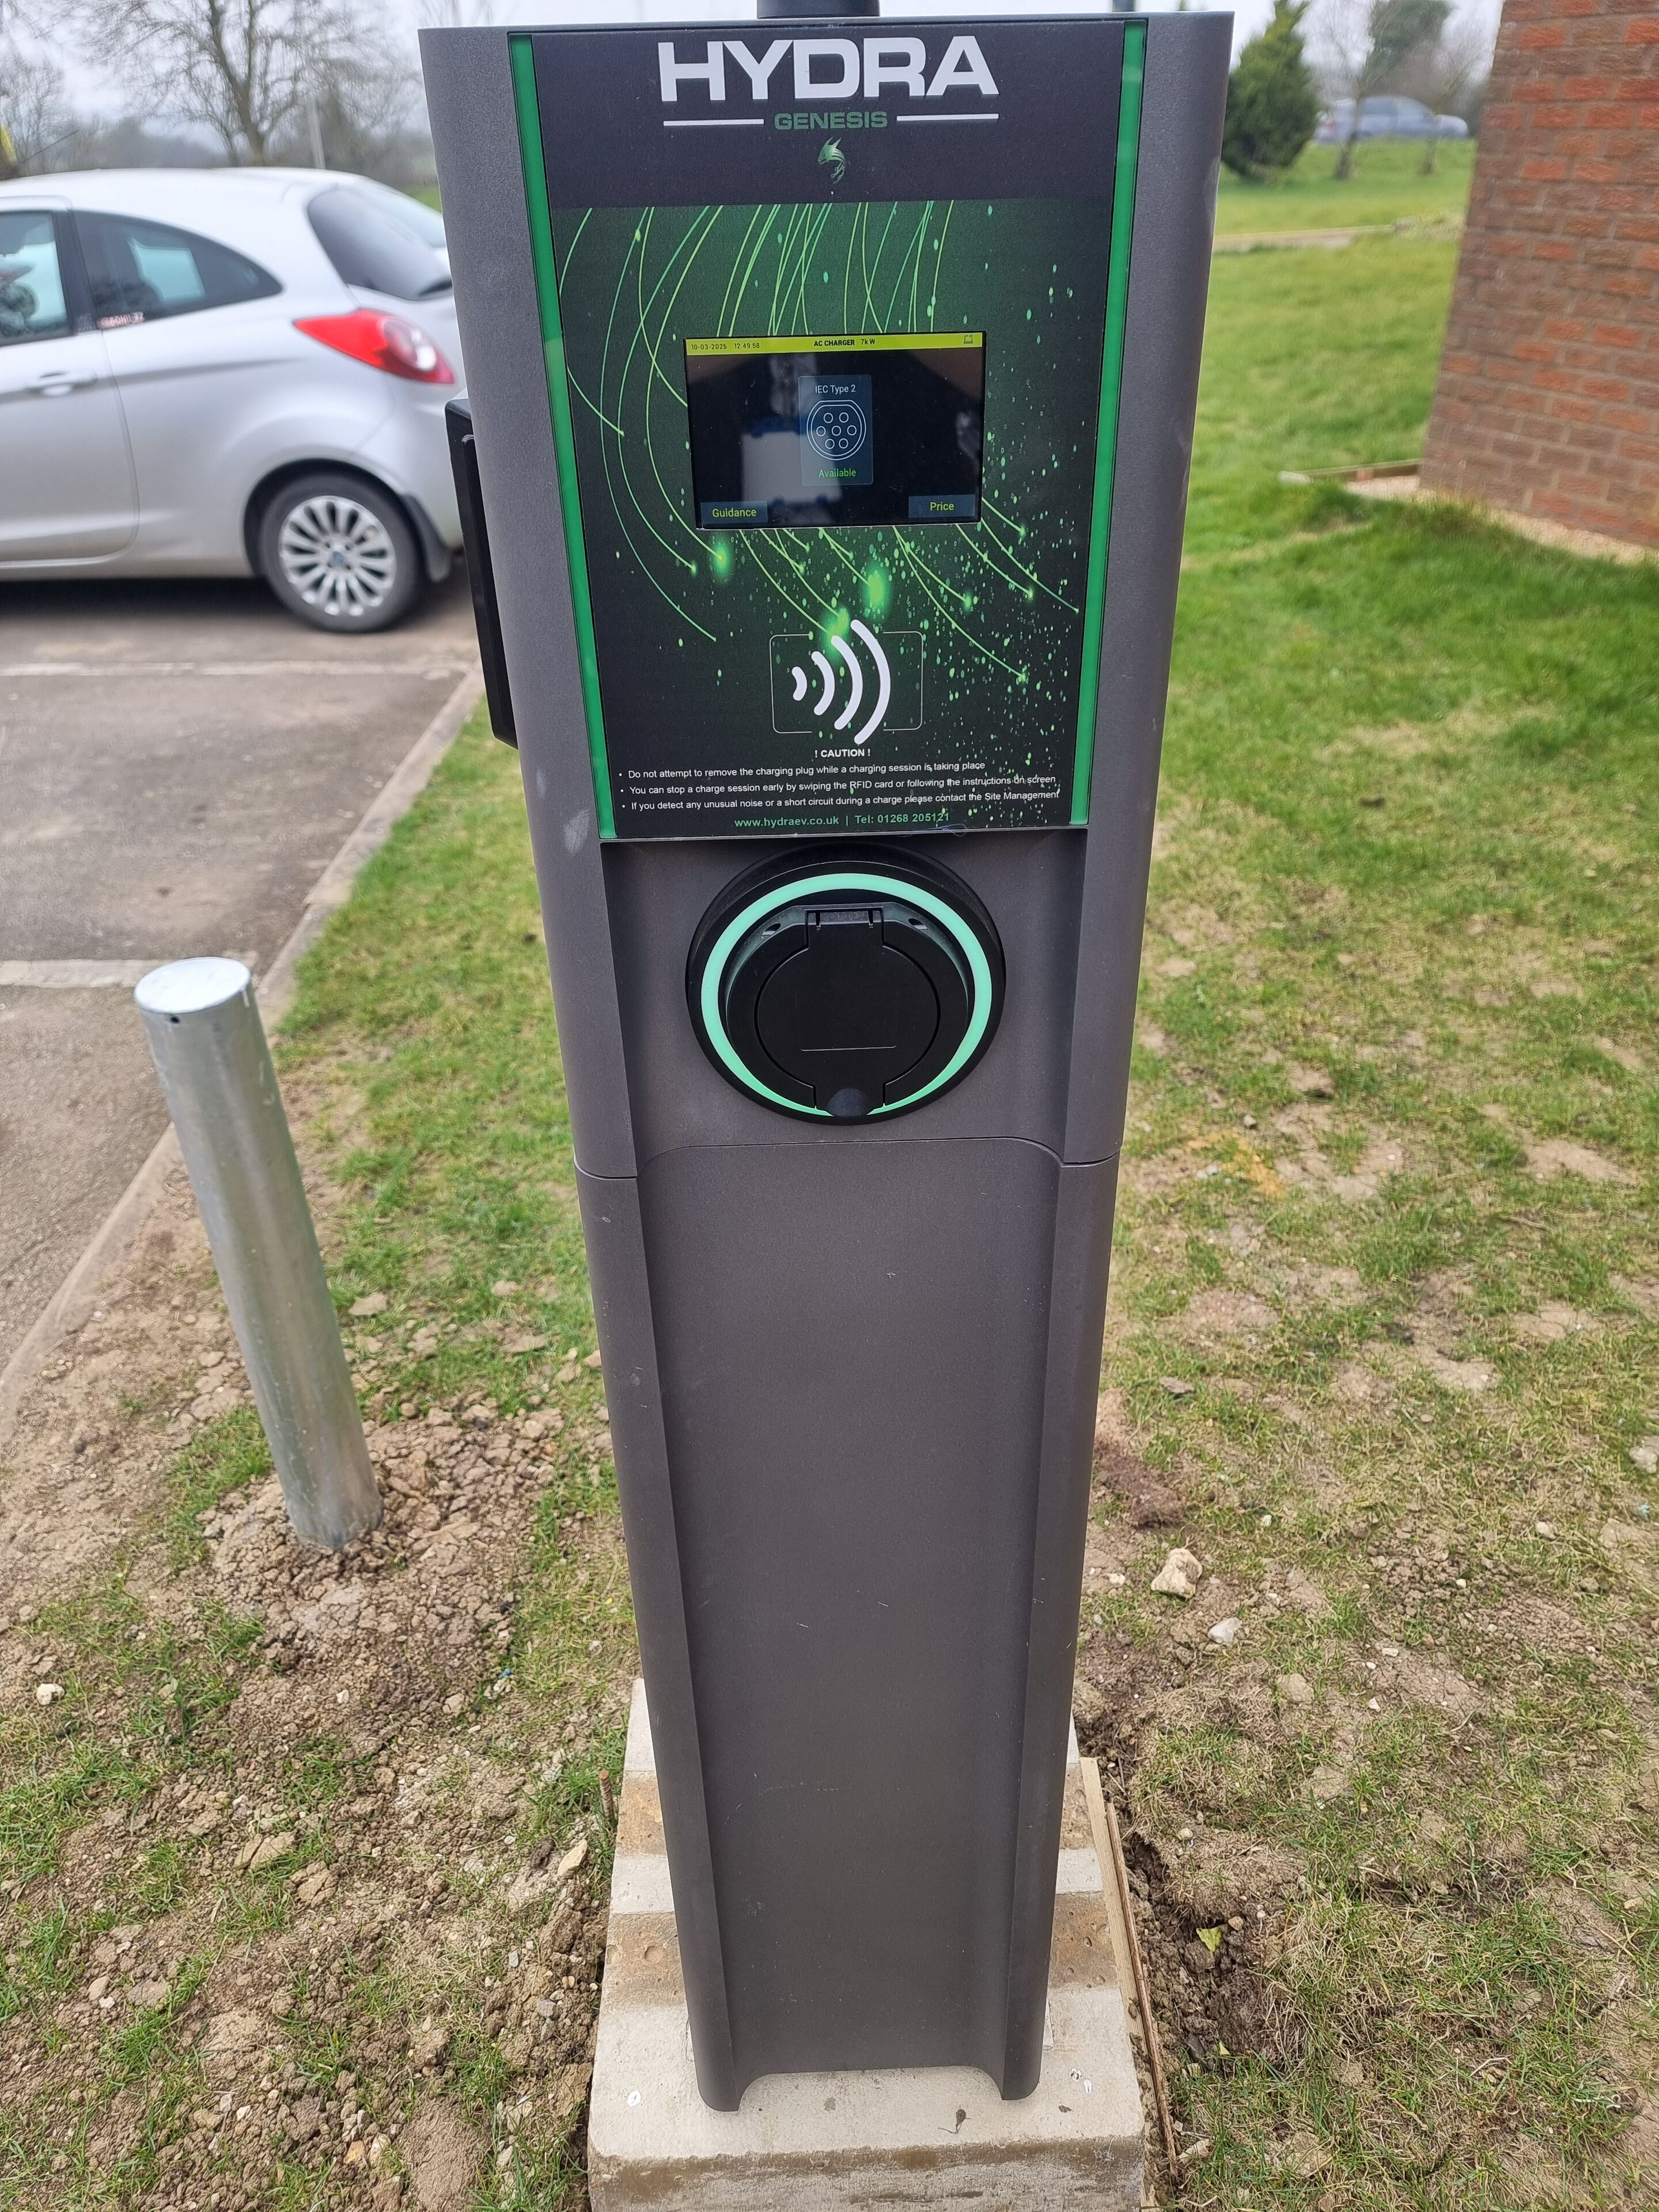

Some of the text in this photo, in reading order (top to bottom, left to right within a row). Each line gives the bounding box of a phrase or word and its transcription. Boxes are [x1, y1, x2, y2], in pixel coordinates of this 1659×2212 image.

[658, 36, 999, 101] HYDRA
[774, 111, 888, 130] GENESIS
[815, 384, 856, 395] IEC Type 2
[818, 468, 857, 478] Available
[712, 507, 757, 517] Guidance
[930, 501, 955, 511] Price
[820, 748, 865, 758] CAUTION
[628, 770, 641, 778] Do
[643, 770, 657, 778] not
[659, 769, 692, 779] attempt
[694, 769, 702, 777] to
[739, 768, 753, 776] the
[756, 767, 793, 777] charging
[796, 766, 814, 777] plug
[816, 766, 839, 774] while
[849, 764, 887, 774] charging
[888, 763, 922, 772] session
[924, 763, 931, 771] is
[933, 762, 960, 772] taking
[962, 761, 986, 772] place
[629, 786, 646, 794] You
[666, 786, 685, 795] stop
[695, 785, 725, 794] charge
[727, 783, 760, 792] session
[763, 783, 784, 793] early
[786, 782, 797, 793] by
[798, 782, 831, 792] swiping
[833, 781, 847, 790] the
[849, 781, 872, 789] RFID
[874, 780, 893, 788] card
[907, 779, 945, 789] following
[946, 778, 960, 786] the
[963, 776, 1012, 786] instructions
[631, 802, 637, 810] If
[639, 803, 655, 812] you
[657, 801, 684, 809] detect
[685, 802, 702, 810] any
[704, 800, 737, 808] unusual
[740, 799, 763, 807] noise
[784, 798, 806, 806] short
[808, 797, 834, 806] circuit
[836, 797, 862, 806] during
[873, 796, 902, 805] charge
[904, 794, 933, 805] please
[935, 793, 967, 802] contact
[968, 793, 982, 801] the
[984, 792, 1002, 801] Site
[1003, 791, 1060, 803] Management
[734, 816, 839, 828] www.hydraev.co.uk
[854, 815, 874, 824] Tel:
[877, 813, 908, 823] 01268
[912, 812, 949, 823] 205121
